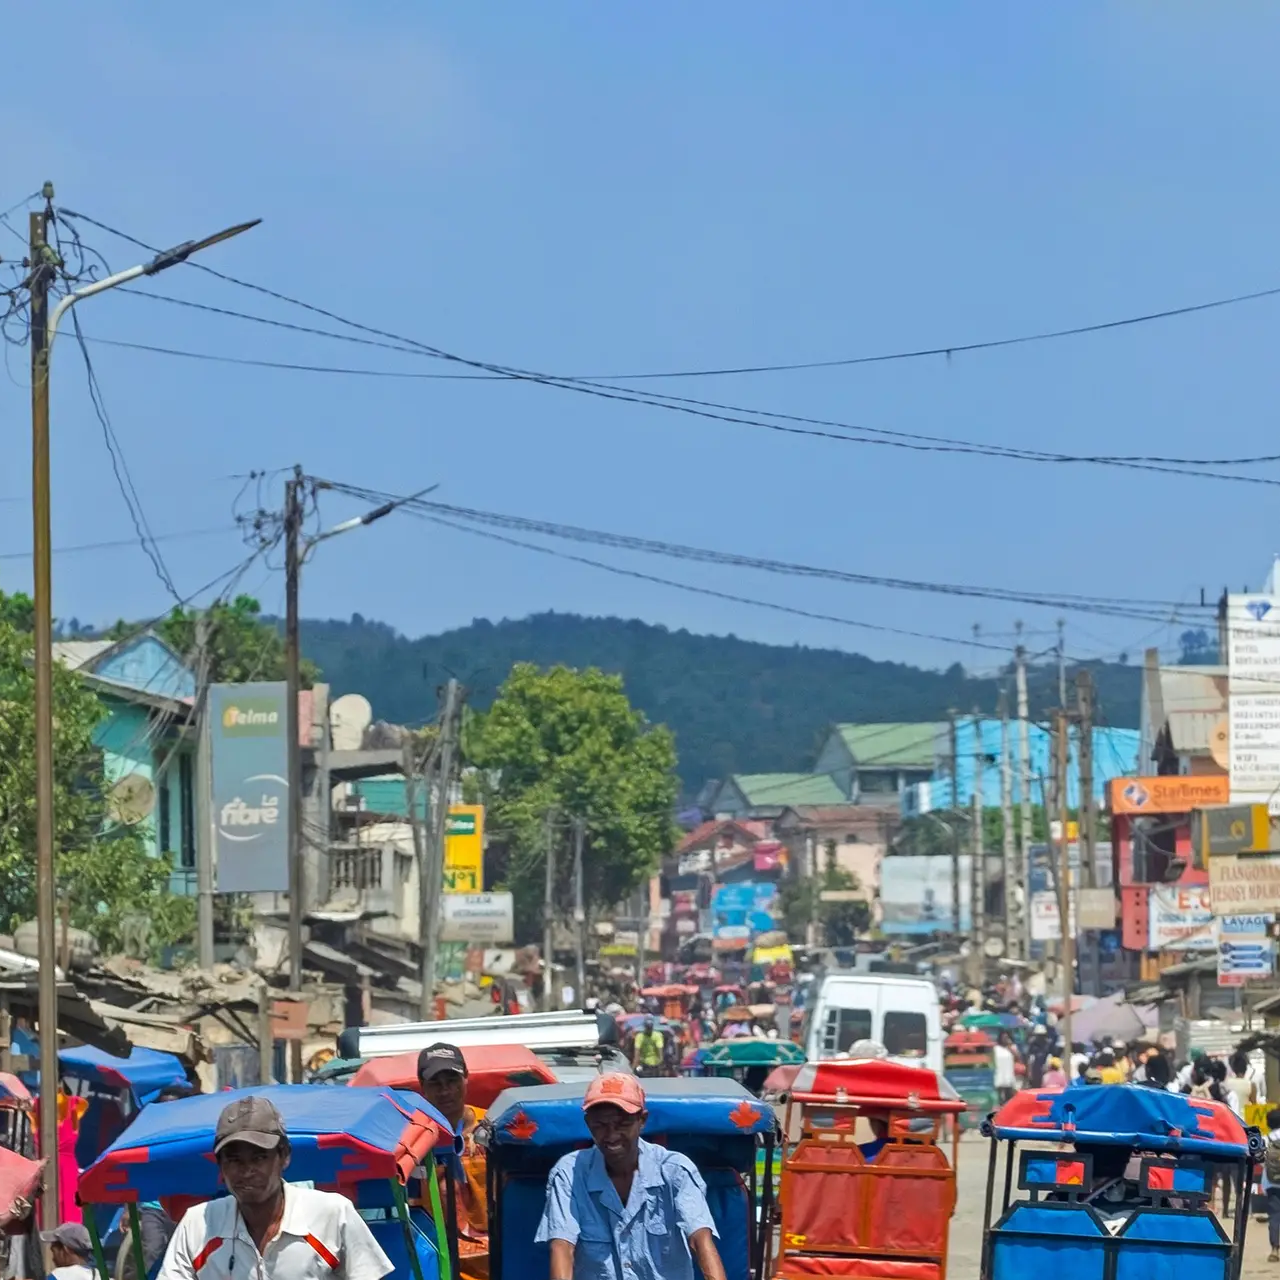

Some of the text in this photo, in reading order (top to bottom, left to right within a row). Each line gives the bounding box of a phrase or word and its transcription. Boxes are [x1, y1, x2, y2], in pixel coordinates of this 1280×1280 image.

[223, 706, 278, 728] Telma
[1153, 783, 1222, 799] StarTimes
[221, 797, 280, 826] fibre
[1222, 915, 1270, 927] LAVAGE
